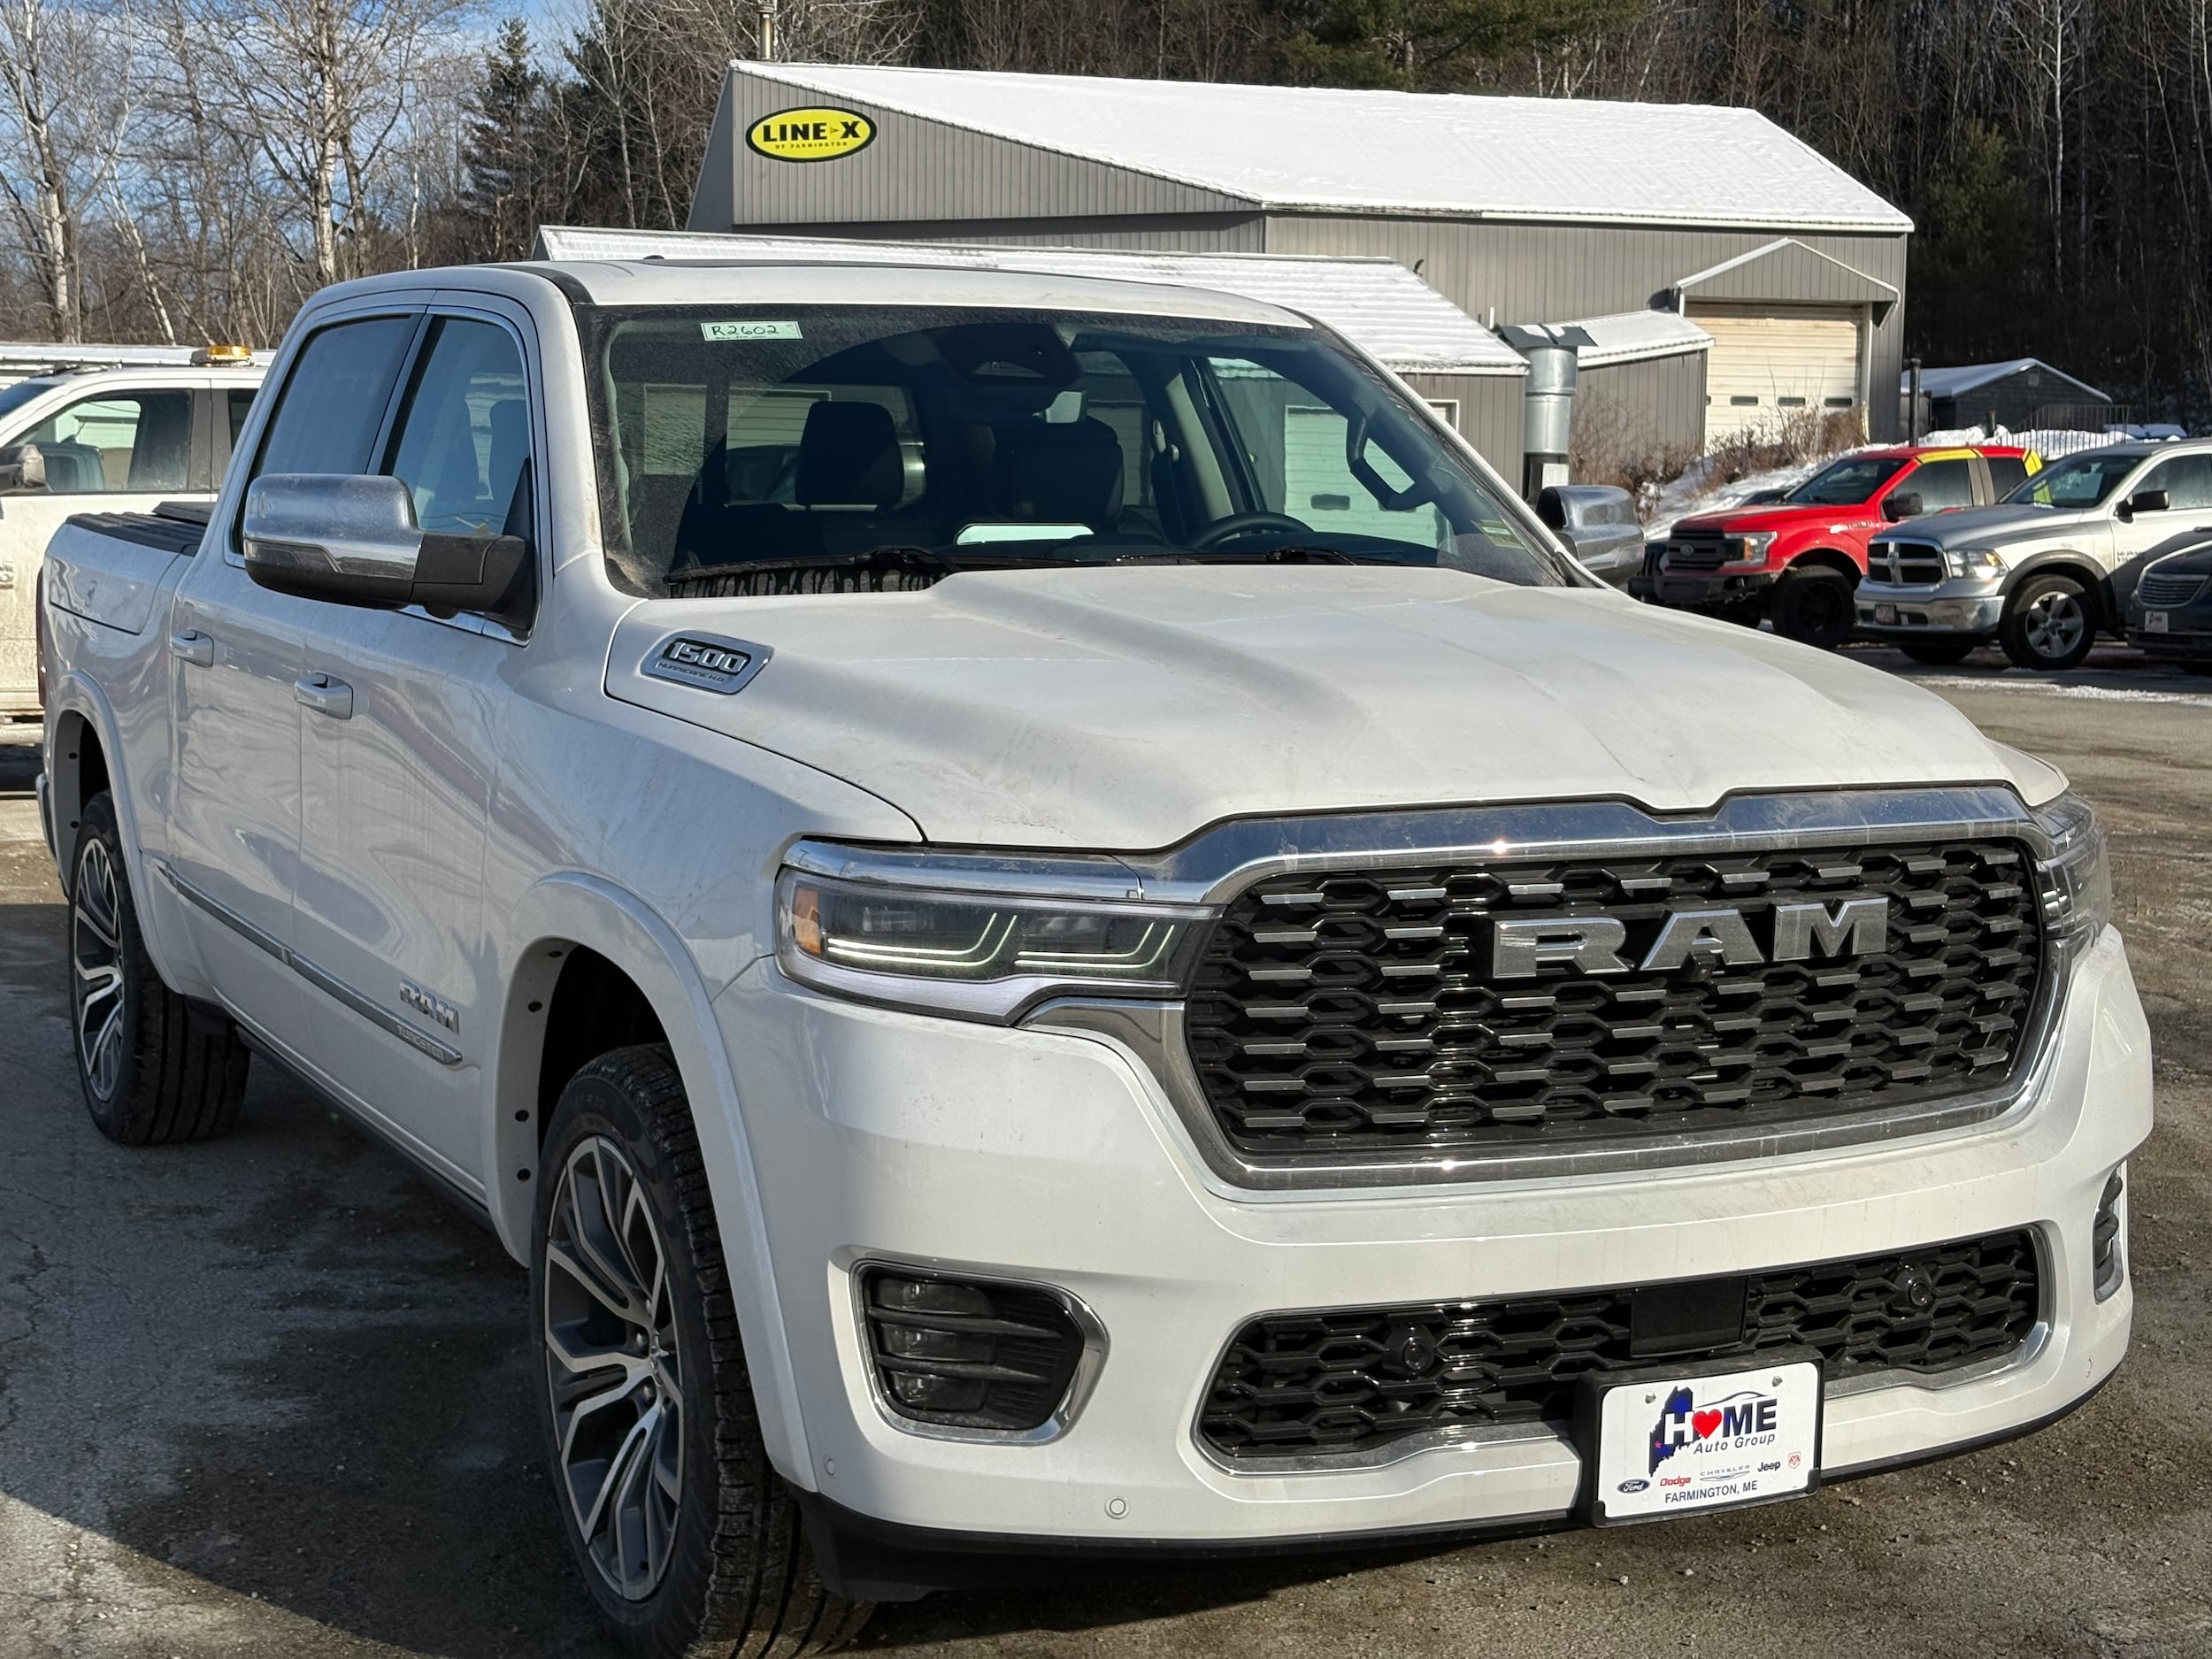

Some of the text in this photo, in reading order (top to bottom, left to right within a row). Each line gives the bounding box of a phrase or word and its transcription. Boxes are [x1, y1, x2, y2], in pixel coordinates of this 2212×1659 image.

[710, 325, 779, 336] R2602
[668, 641, 748, 672] 1500
[1493, 896, 1888, 978] RAM
[399, 978, 460, 1034] RAM
[1694, 1433, 1776, 1455] Auto Group
[1623, 1461, 1781, 1492] Ford Dodge CHRYSLER Jeep
[1664, 1480, 1758, 1503] FARMINGTON, ME
